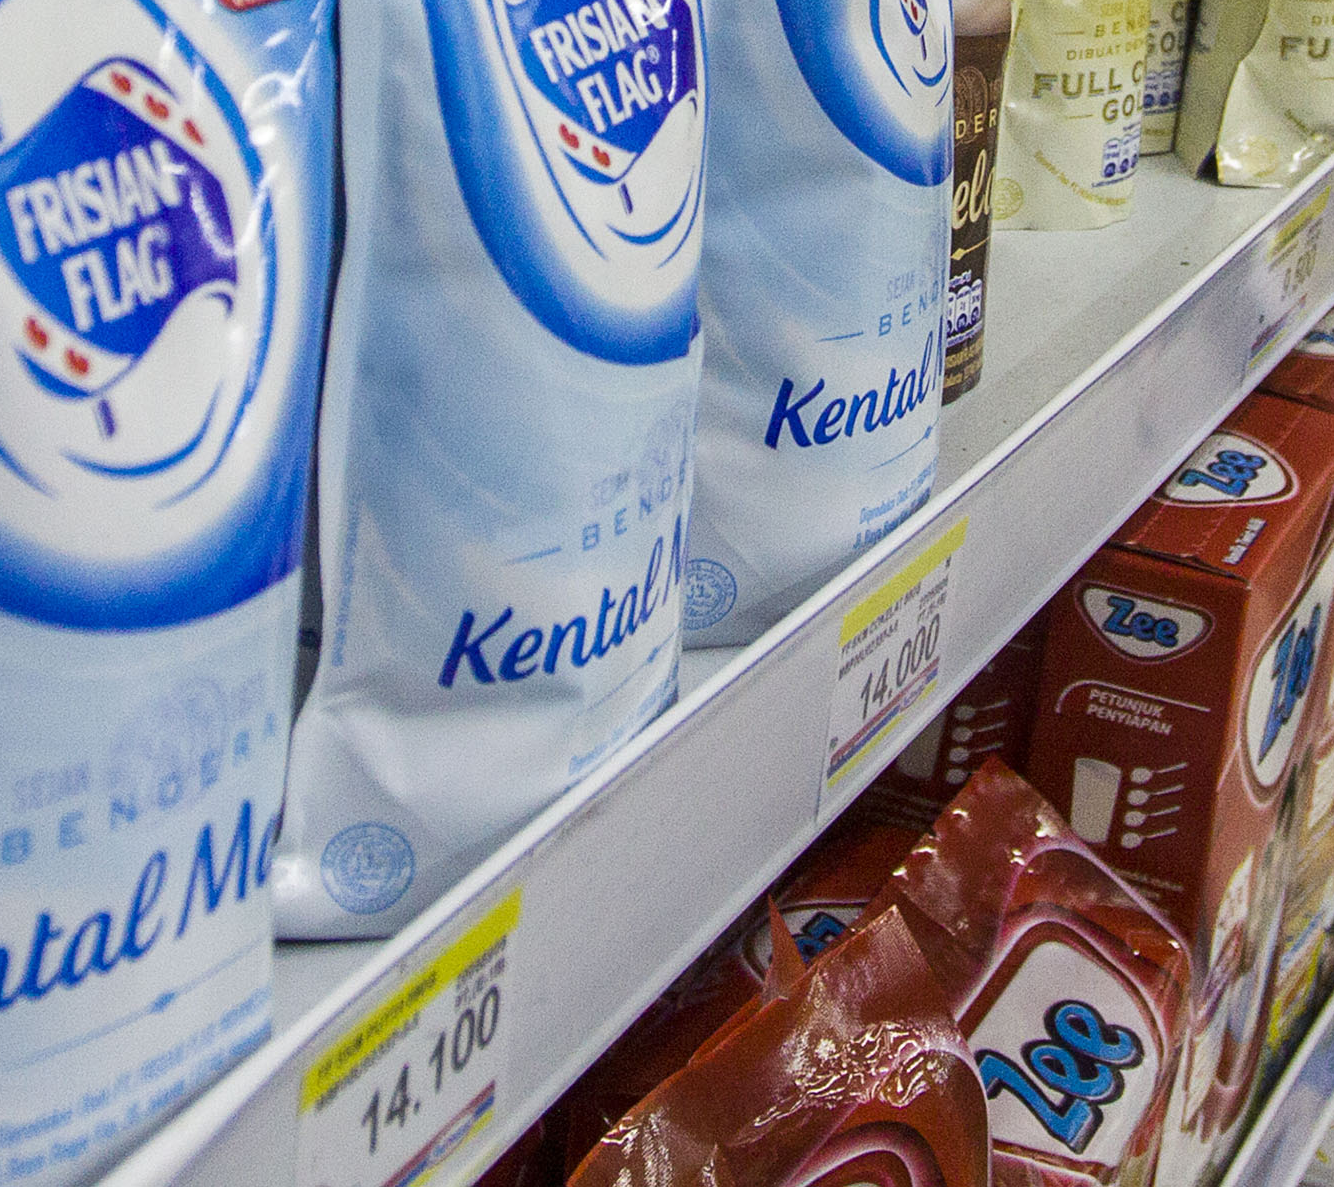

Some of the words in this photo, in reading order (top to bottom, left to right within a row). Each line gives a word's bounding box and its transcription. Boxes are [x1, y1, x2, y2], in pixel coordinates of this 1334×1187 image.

[574, 59, 661, 134] FLAG
[1031, 67, 1123, 99] FULL
[1067, 44, 1121, 62] DIBUAT
[6, 140, 171, 263] FRISIAN
[63, 229, 173, 332] FLAG
[765, 330, 931, 450] Kental
[1178, 449, 1267, 498] Zee
[438, 535, 664, 688] Kental
[1103, 595, 1180, 648] Zee
[861, 612, 941, 720] 14.000
[1089, 688, 1165, 719] PETUNJUK
[1086, 703, 1173, 736] PENYIAPAN
[362, 983, 501, 1155] 14.100
[976, 998, 1145, 1155] Zee
